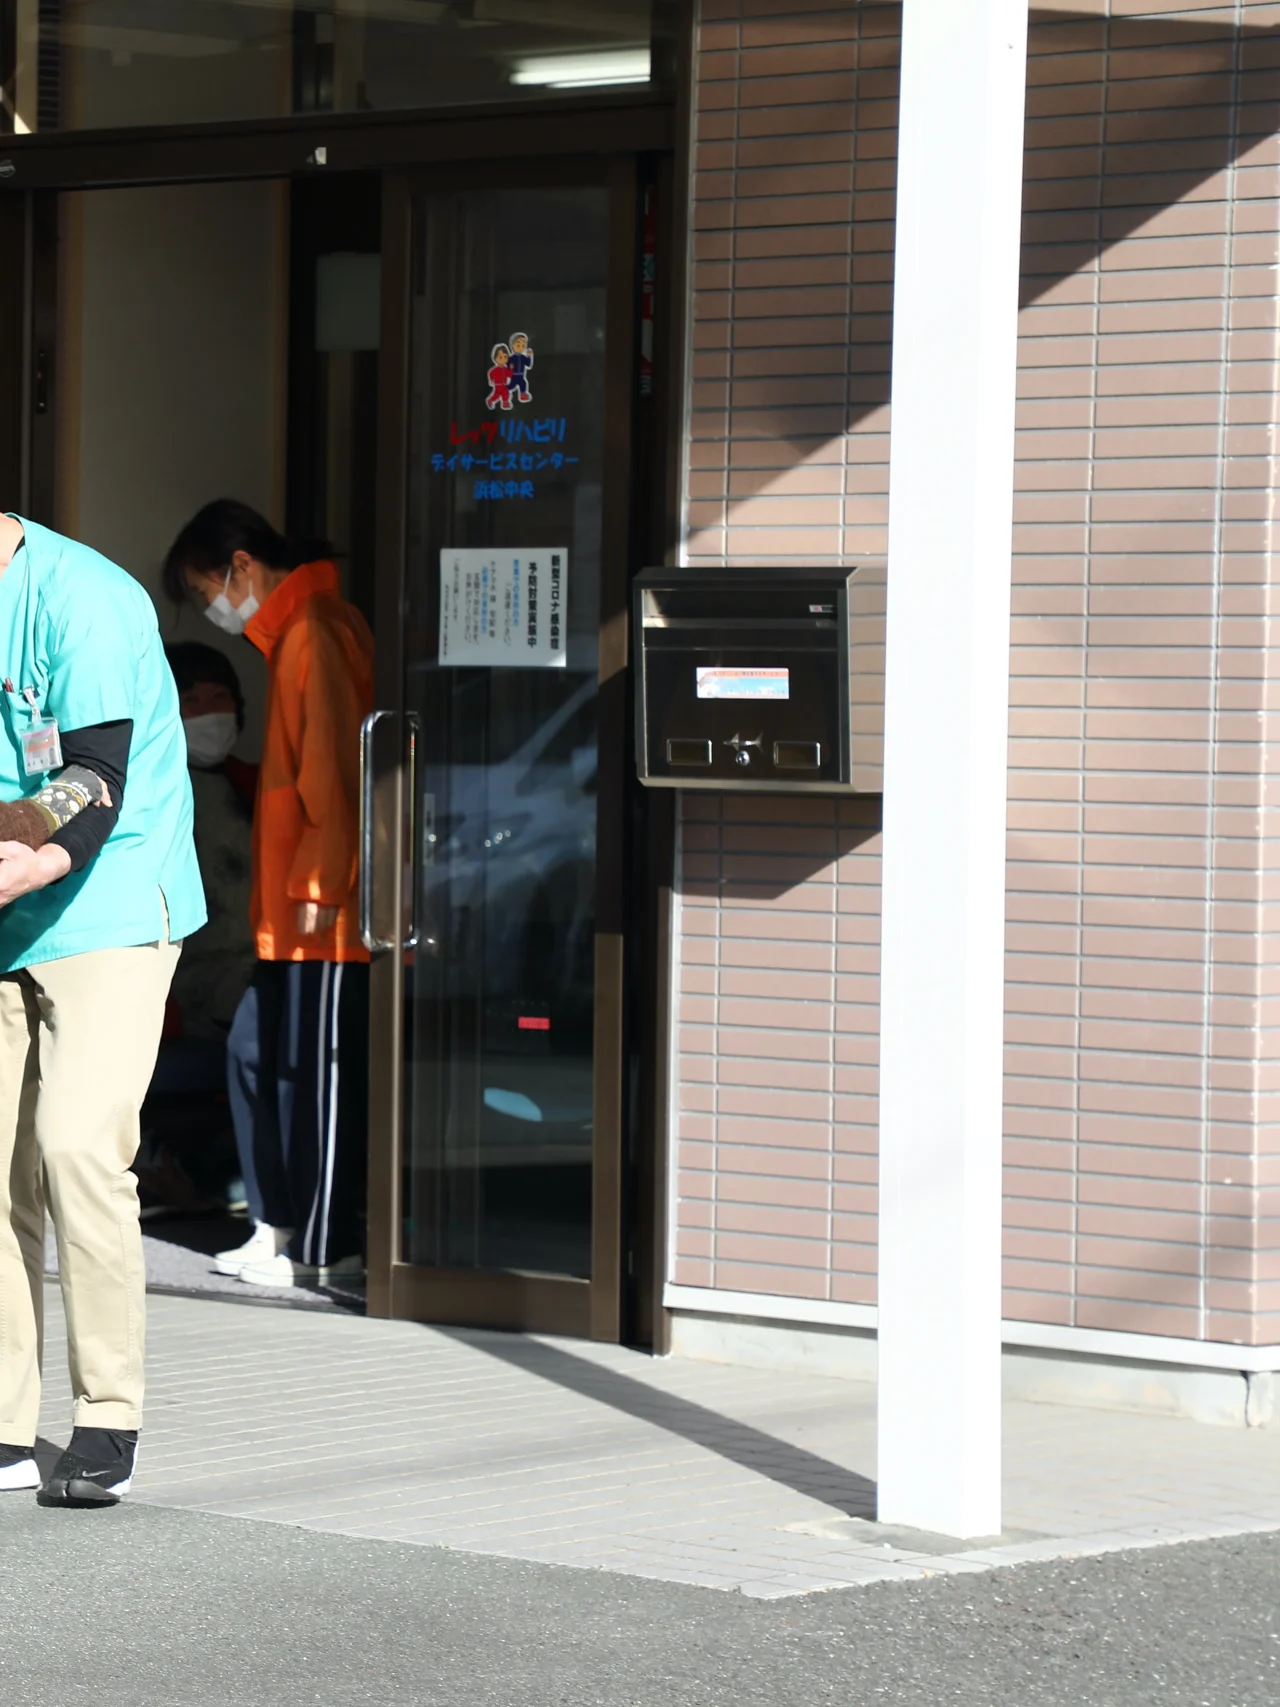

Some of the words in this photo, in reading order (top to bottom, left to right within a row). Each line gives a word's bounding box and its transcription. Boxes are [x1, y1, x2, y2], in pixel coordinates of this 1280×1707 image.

[450, 417, 567, 445] レッツリハビリ
[430, 452, 580, 473] デイサービスセンター
[473, 480, 535, 500] 浜松中央
